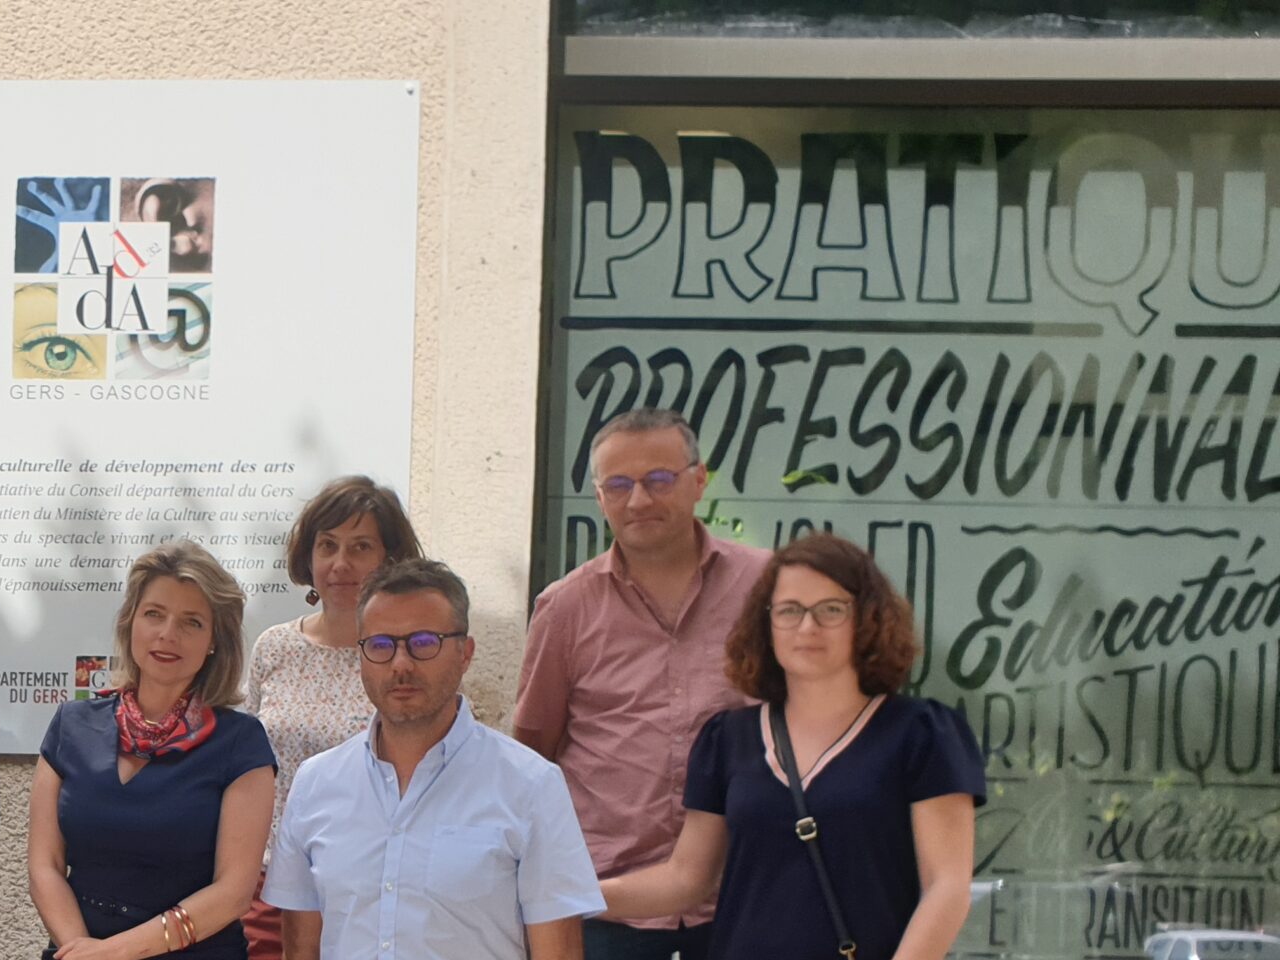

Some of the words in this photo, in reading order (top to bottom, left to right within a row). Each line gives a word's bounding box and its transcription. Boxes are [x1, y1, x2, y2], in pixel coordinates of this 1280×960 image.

[9, 384, 65, 400] GERS
[89, 384, 211, 401] GASCOGNE
[0, 458, 72, 472] culturelle
[79, 459, 98, 473] de
[104, 459, 223, 477] développement
[230, 459, 257, 473] des
[264, 460, 296, 473] arts
[47, 483, 65, 497] du
[70, 483, 123, 497] Conseil
[125, 483, 235, 500] départemental
[238, 484, 257, 498] du
[261, 484, 295, 498] Gers
[33, 506, 52, 521] du
[54, 507, 123, 521] Ministère
[124, 508, 144, 522] de
[145, 508, 160, 522] la
[163, 508, 217, 522] Culture
[220, 511, 239, 522] au
[241, 508, 294, 523] service
[13, 530, 32, 544] du
[37, 531, 106, 548] spectacle
[110, 531, 155, 545] vivant
[209, 533, 239, 546] arts
[244, 531, 289, 546] visuel
[34, 557, 62, 569] une
[219, 556, 265, 570] ration
[240, 581, 290, 597] toyens.
[946, 536, 1280, 690] Educatio
[9, 688, 28, 704] DU
[33, 688, 68, 704] GERS
[957, 636, 1280, 789] RTISTIQU
